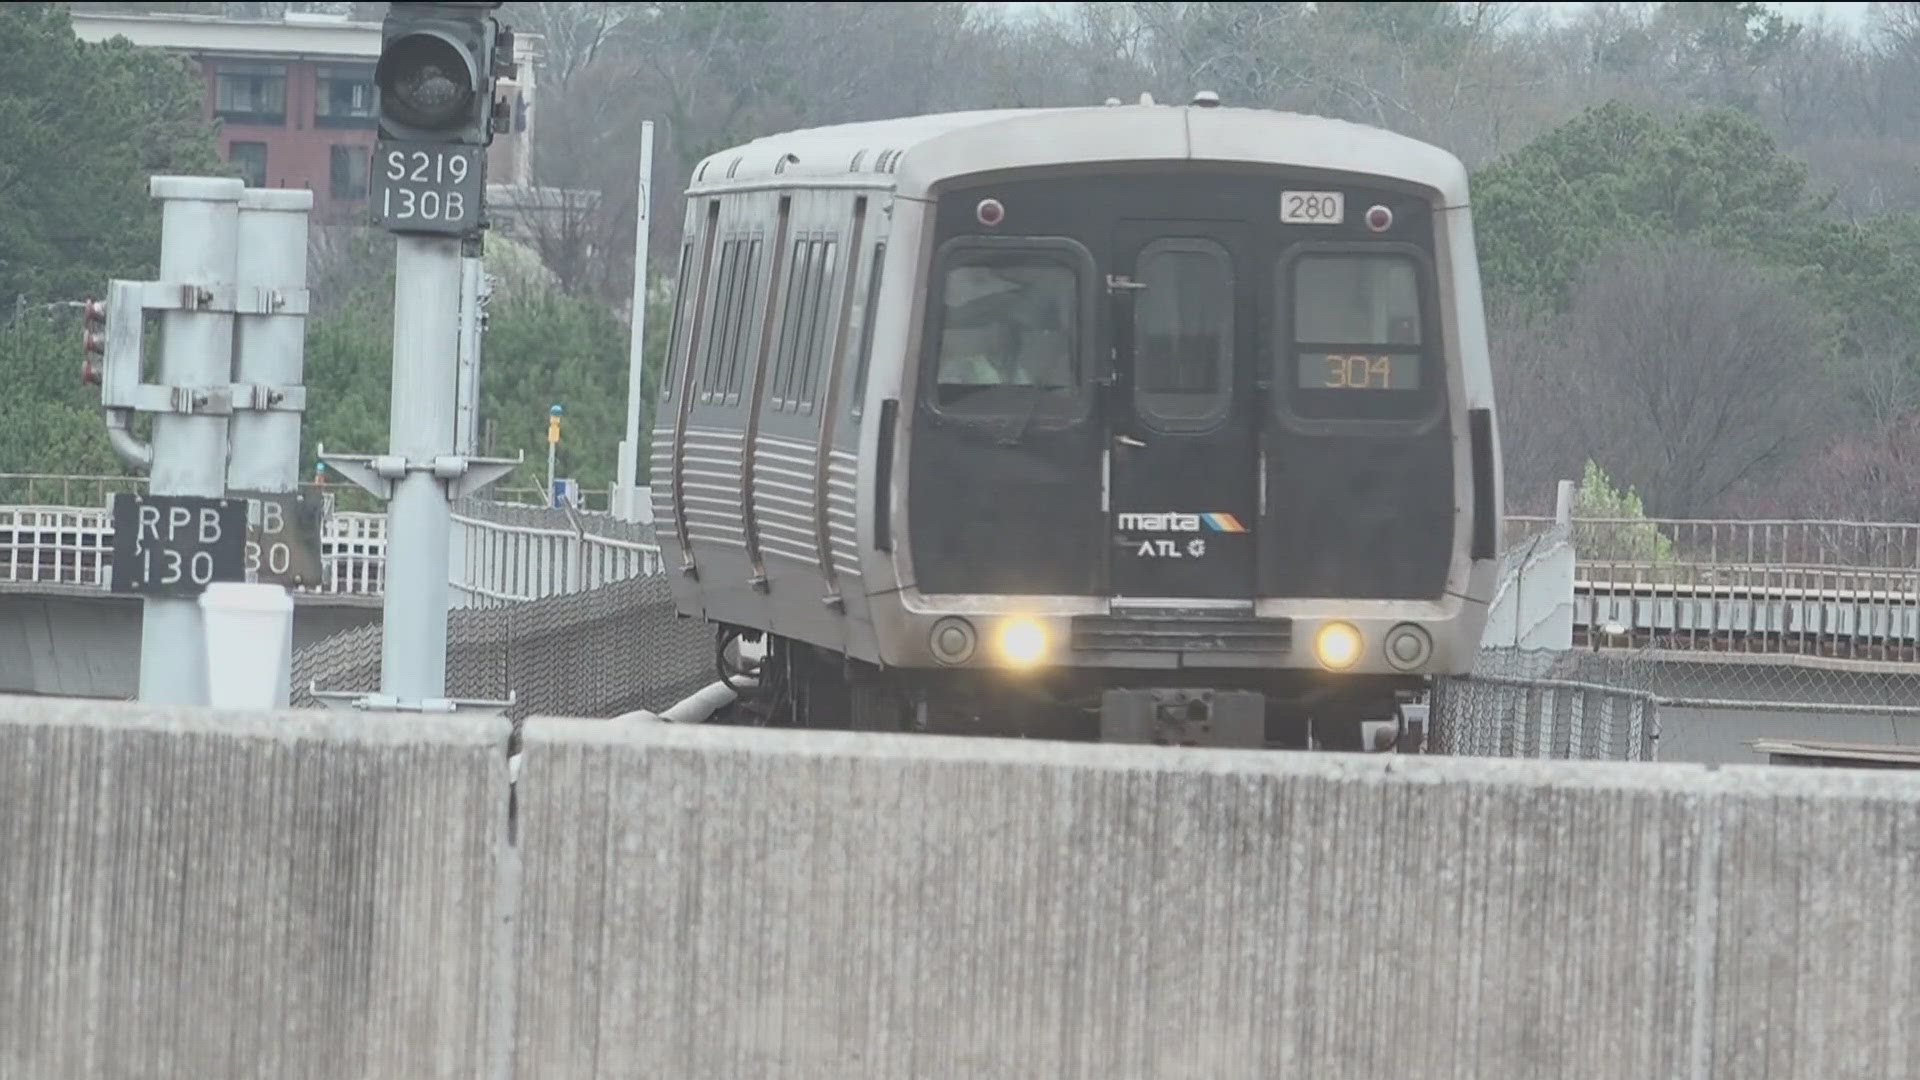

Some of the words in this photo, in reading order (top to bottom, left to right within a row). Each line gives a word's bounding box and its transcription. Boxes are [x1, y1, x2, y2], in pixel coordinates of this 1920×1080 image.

[387, 151, 468, 184] S219
[383, 187, 465, 221] 130B
[1288, 195, 1337, 218] 280
[1325, 355, 1389, 389] 304
[138, 506, 222, 543] RPB
[1118, 512, 1200, 531] marta
[1137, 540, 1183, 557] ATL
[143, 549, 214, 584] 130
